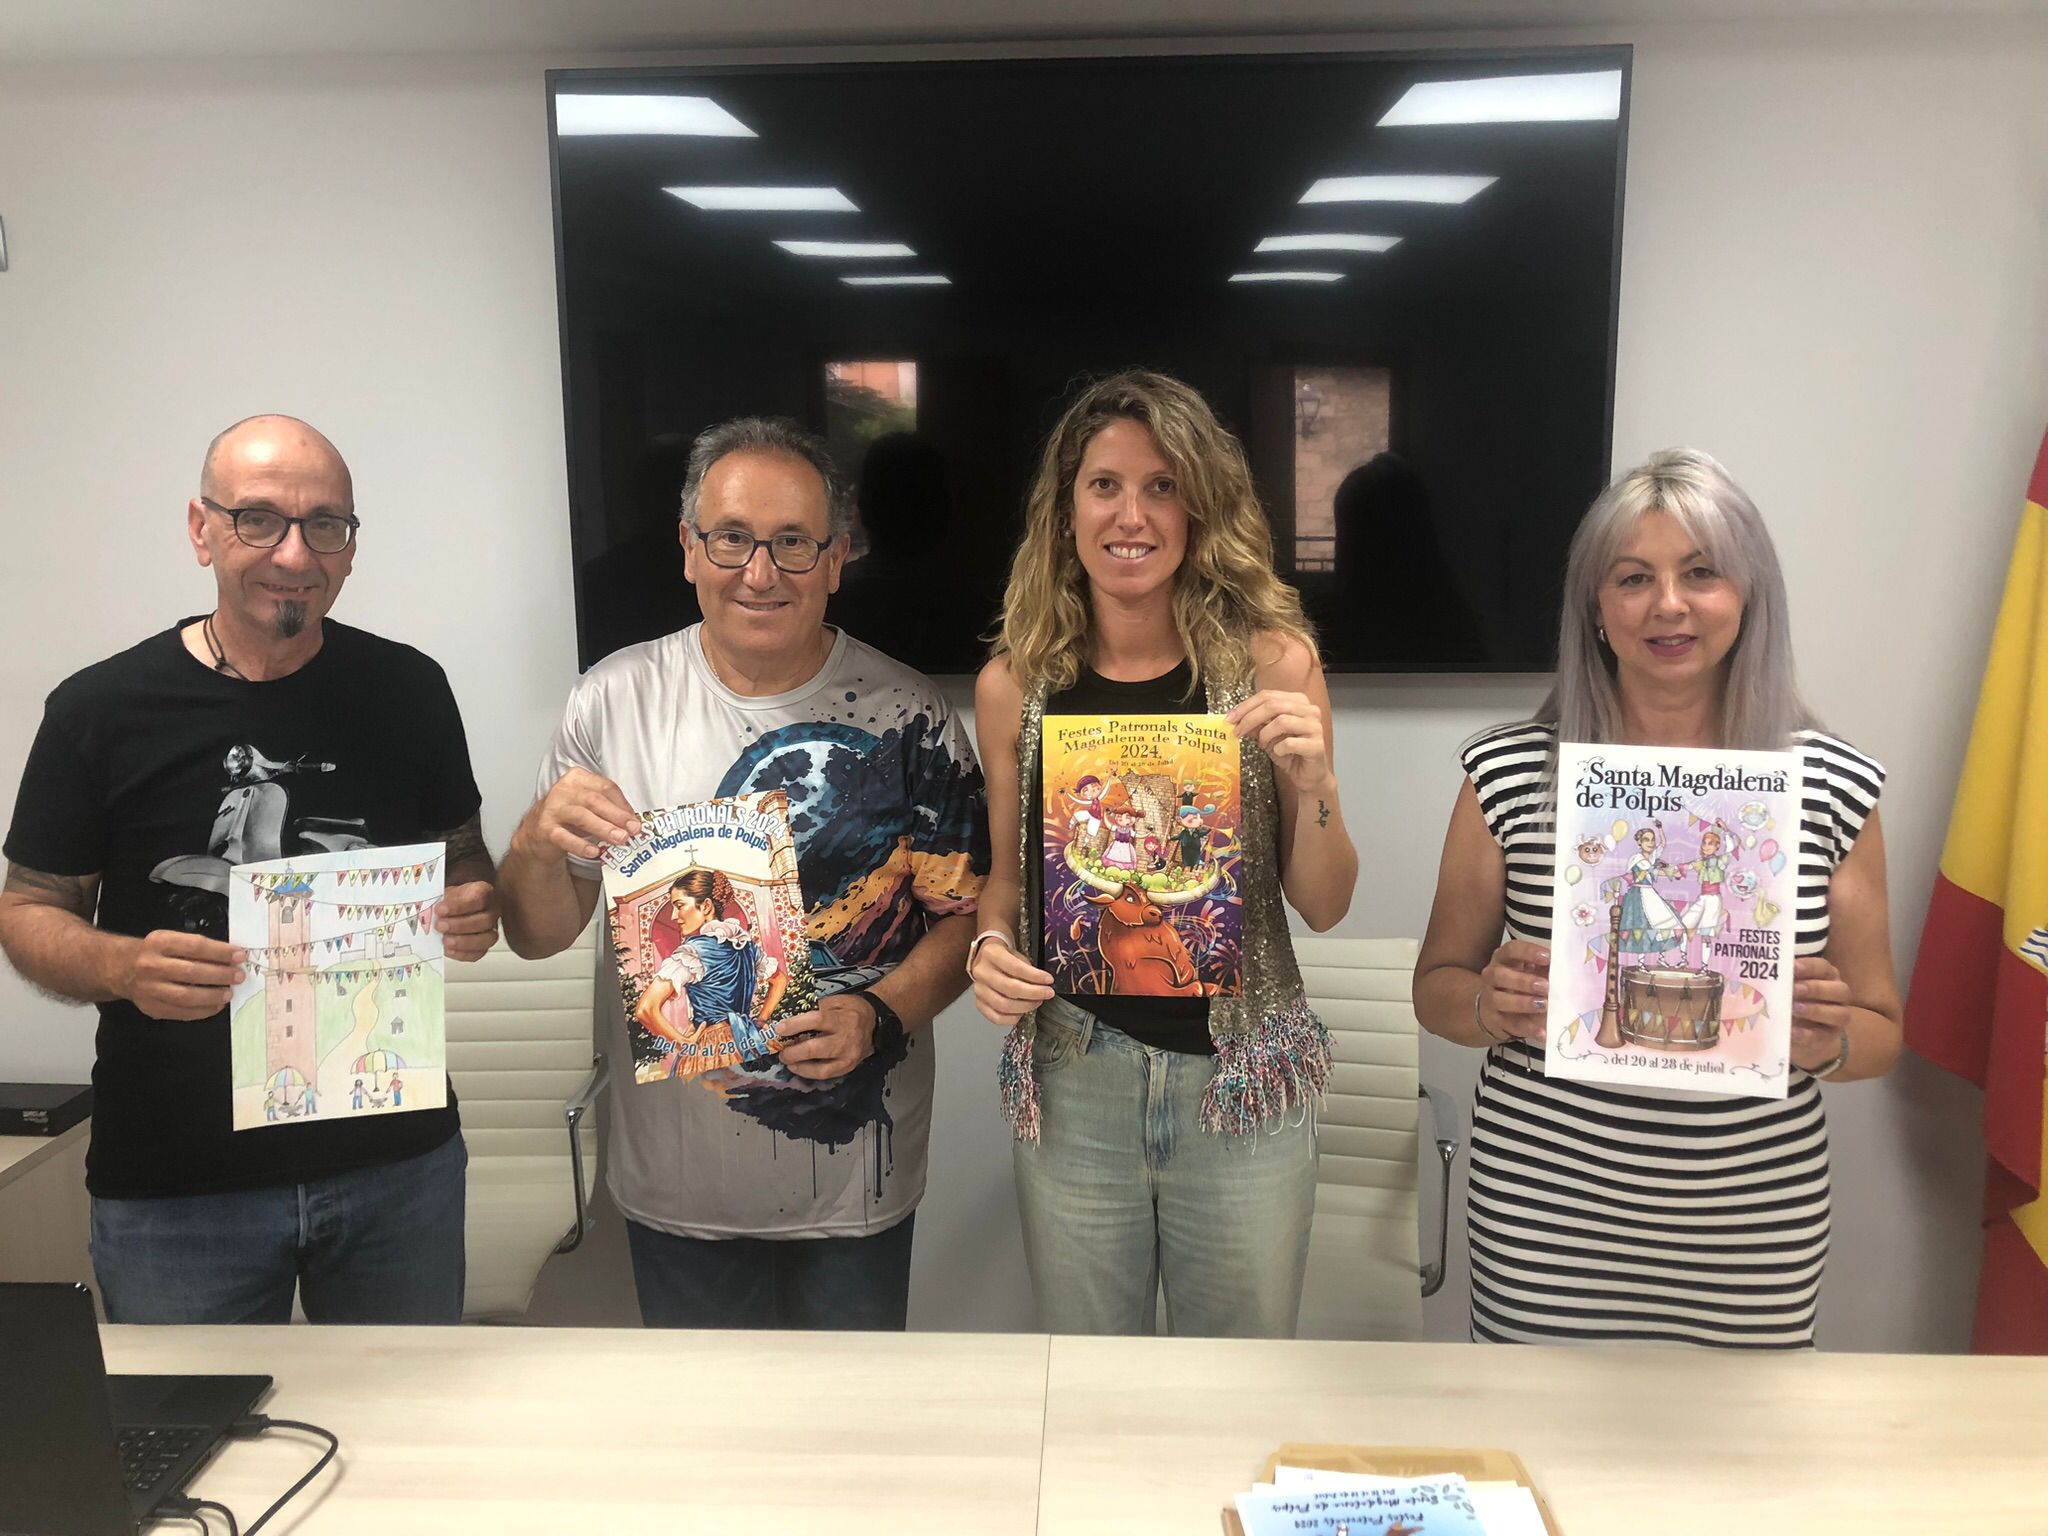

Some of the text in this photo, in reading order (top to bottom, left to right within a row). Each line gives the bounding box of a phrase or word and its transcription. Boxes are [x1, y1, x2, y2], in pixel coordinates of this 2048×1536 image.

[1058, 720, 1227, 741] Festes Patronals Santa
[1063, 734, 1145, 755] Magdalena
[1152, 734, 1170, 743] de
[1588, 760, 1787, 796] Santa Magdalena
[1576, 786, 1682, 817] de Polpís
[653, 804, 744, 835] PATRONALS
[745, 809, 788, 841] 2024
[619, 824, 769, 878] Santa Magdalena de Polpis
[1739, 929, 1781, 944] FESTES
[1714, 943, 1779, 960] PATRONALS
[1740, 961, 1778, 980] 2024
[653, 1037, 676, 1054] Del
[680, 1043, 696, 1056] 20
[701, 1045, 714, 1057] al
[720, 1042, 736, 1055] 28
[740, 1036, 756, 1050] de
[1611, 1054, 1725, 1075] del 20 al 28 de juliol
